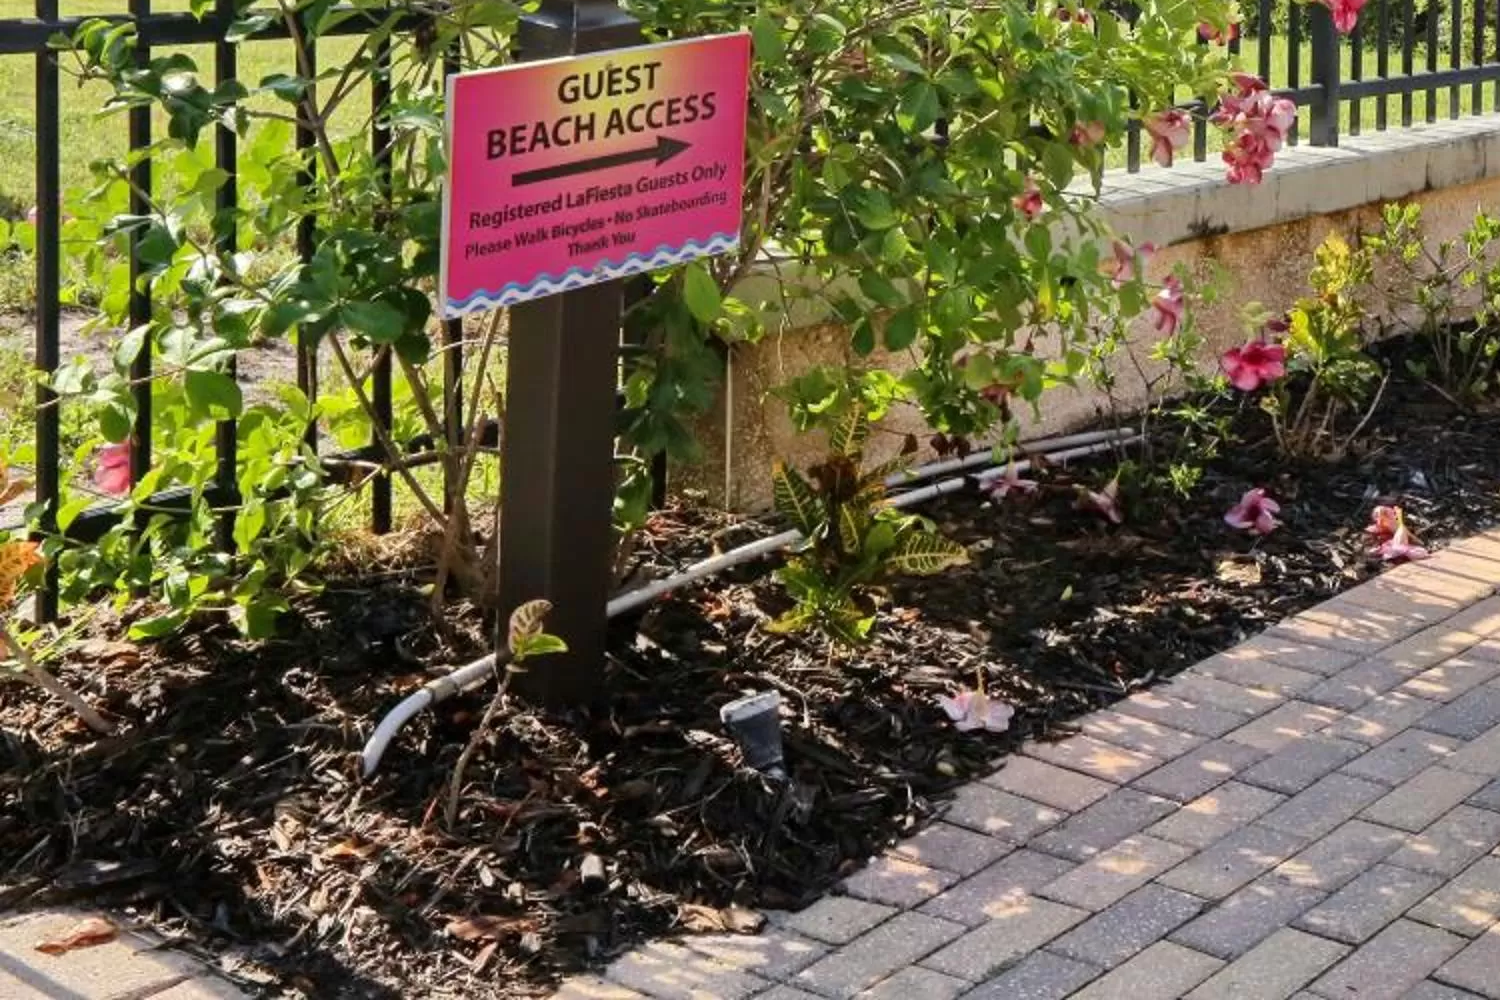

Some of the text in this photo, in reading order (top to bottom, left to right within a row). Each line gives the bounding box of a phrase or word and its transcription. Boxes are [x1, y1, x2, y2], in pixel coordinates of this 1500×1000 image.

[557, 61, 662, 104] GUEST
[486, 91, 716, 161] BEACH ACCESS
[465, 191, 727, 259] Please Walk Bicycles No Skateboarding
[469, 161, 727, 229] Registered LaFiesta Guests Only
[567, 231, 636, 257] Thank You
